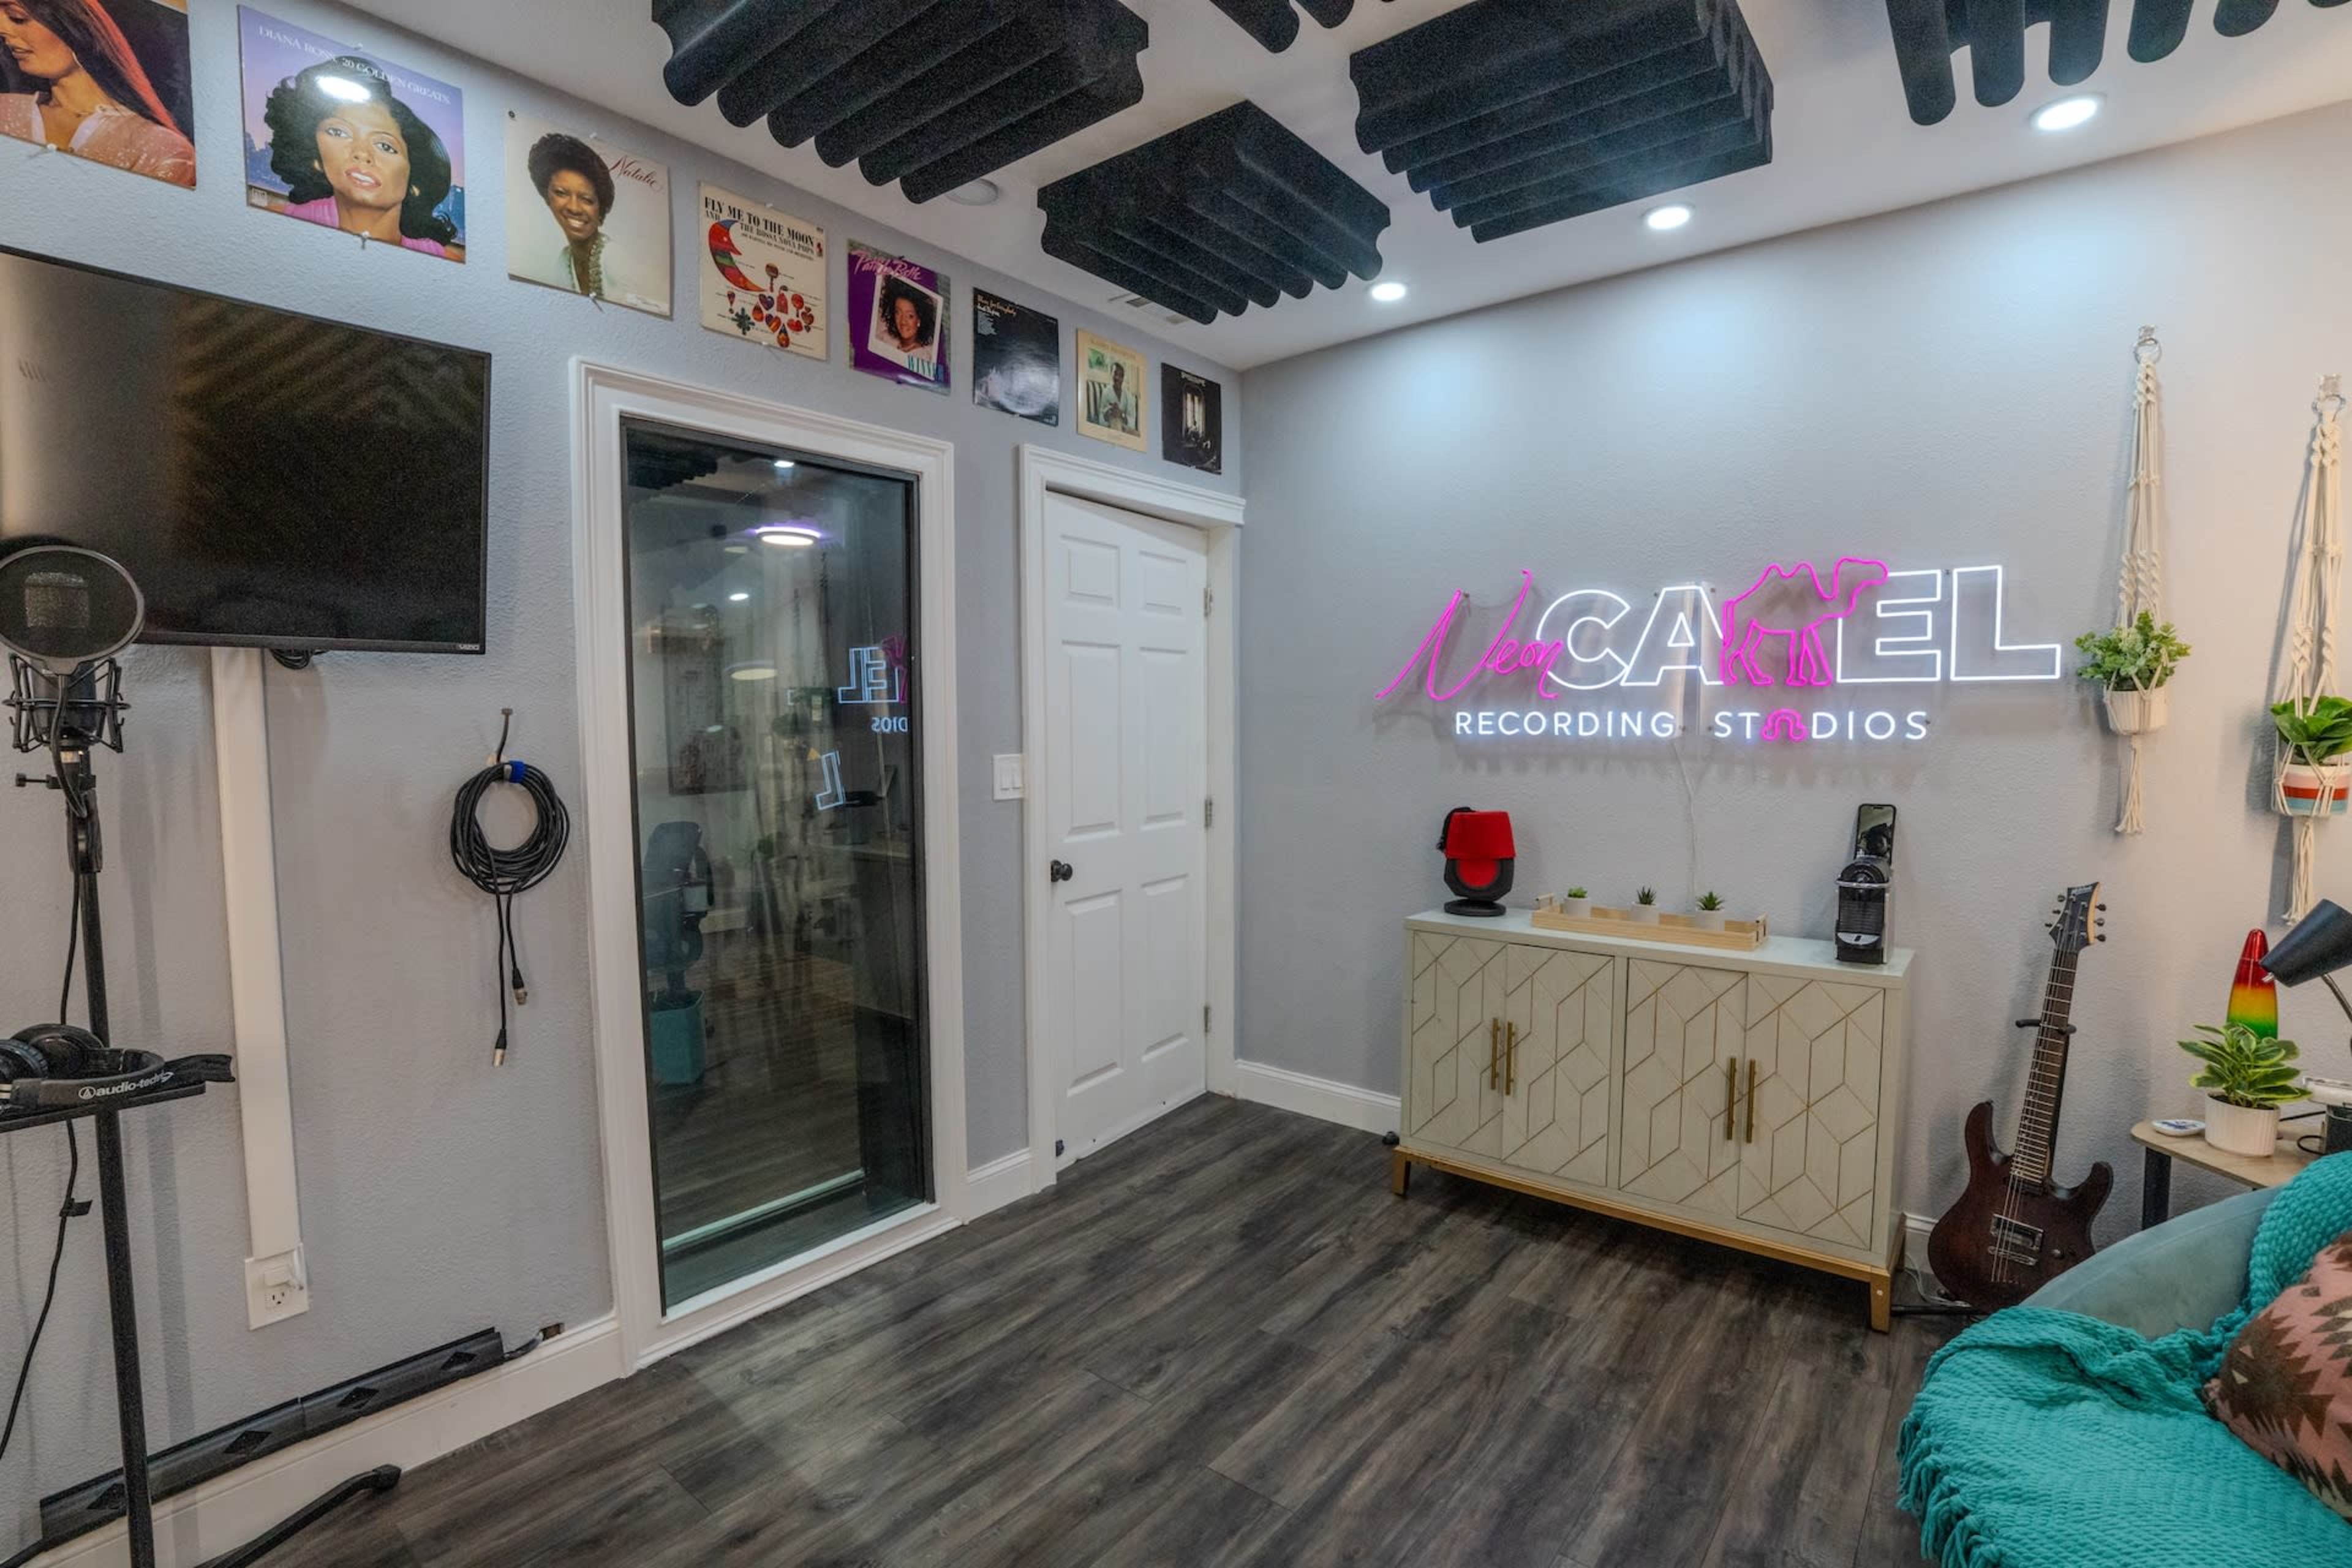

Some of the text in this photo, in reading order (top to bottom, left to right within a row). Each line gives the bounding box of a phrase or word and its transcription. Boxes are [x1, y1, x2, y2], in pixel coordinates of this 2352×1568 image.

[259, 26, 301, 50] DIANA
[356, 62, 405, 87] GOLDEN
[407, 80, 451, 105] GREATS
[609, 156, 659, 189] Natalie
[705, 196, 725, 214] FLY
[726, 205, 744, 222] ME
[747, 212, 760, 227] TO
[763, 217, 785, 236] THE
[786, 227, 814, 247] MOON
[1376, 568, 1563, 701] Neon
[1455, 710, 1677, 737] RECORDING
[96, 1069, 174, 1096] audio-tech
